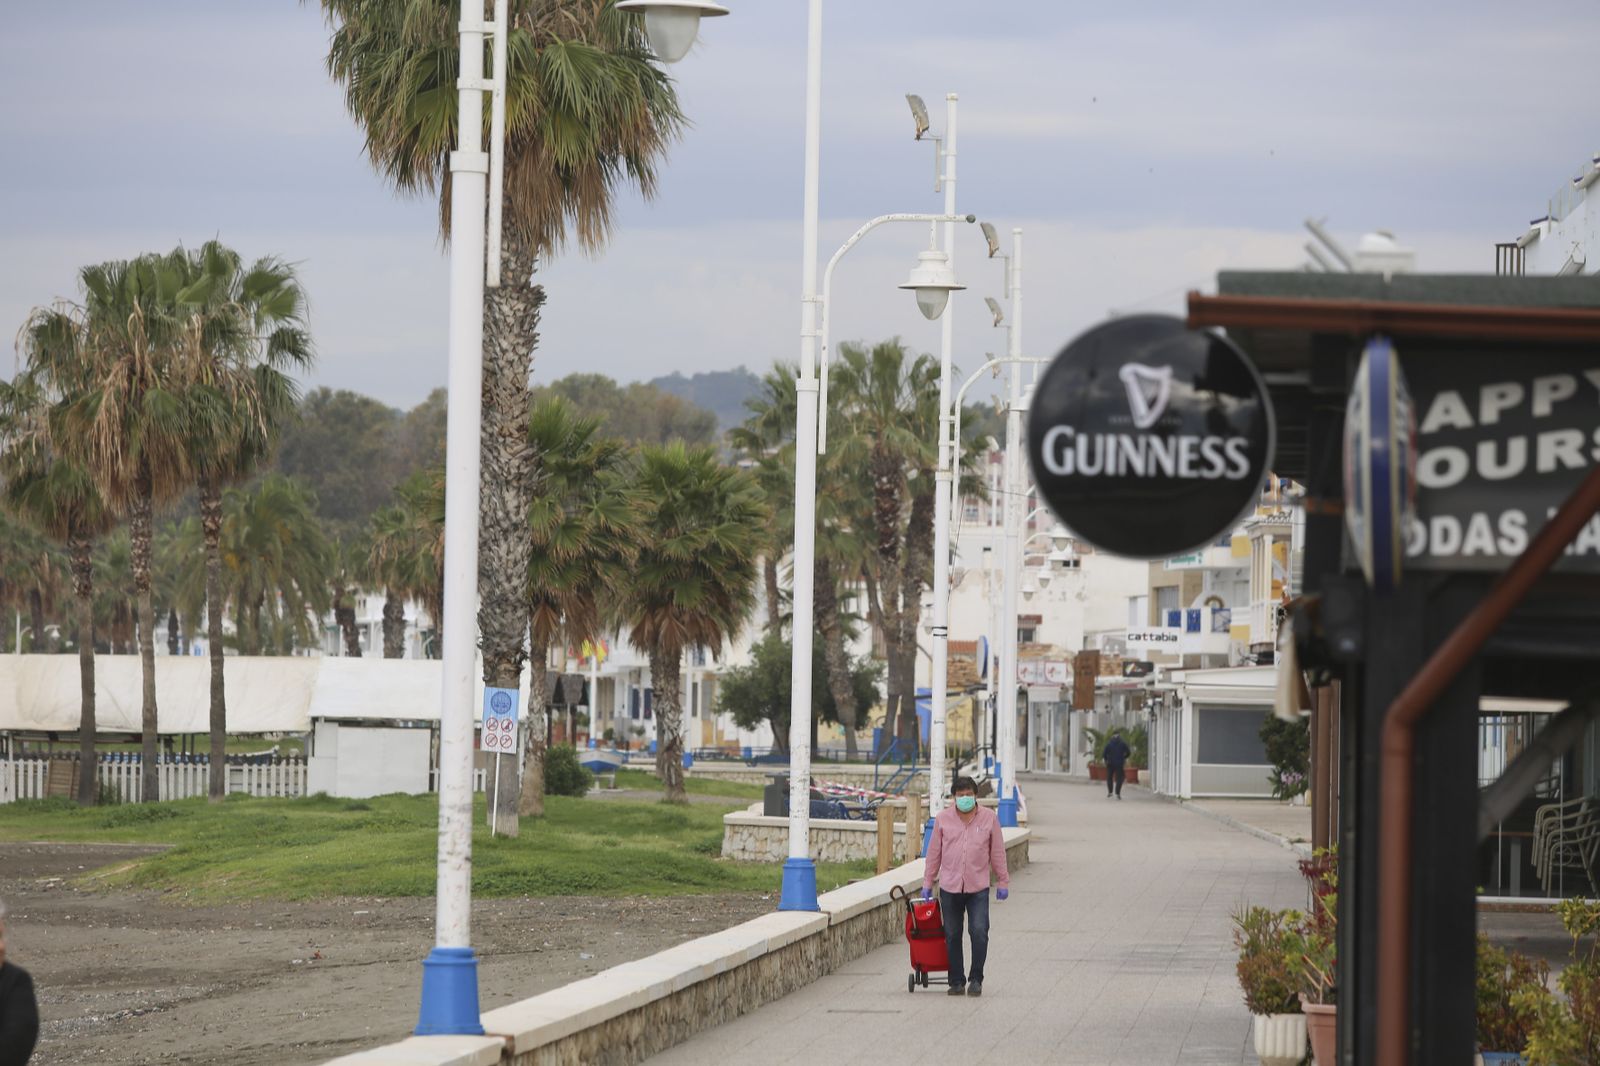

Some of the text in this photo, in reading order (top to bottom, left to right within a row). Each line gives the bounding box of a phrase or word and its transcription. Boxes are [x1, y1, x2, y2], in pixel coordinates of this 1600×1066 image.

[1420, 369, 1600, 434] APP
[1041, 424, 1250, 480] GUINNESS
[1415, 424, 1600, 489] OUR
[1403, 508, 1529, 557] ODAS
[1127, 632, 1178, 642] cattabia
